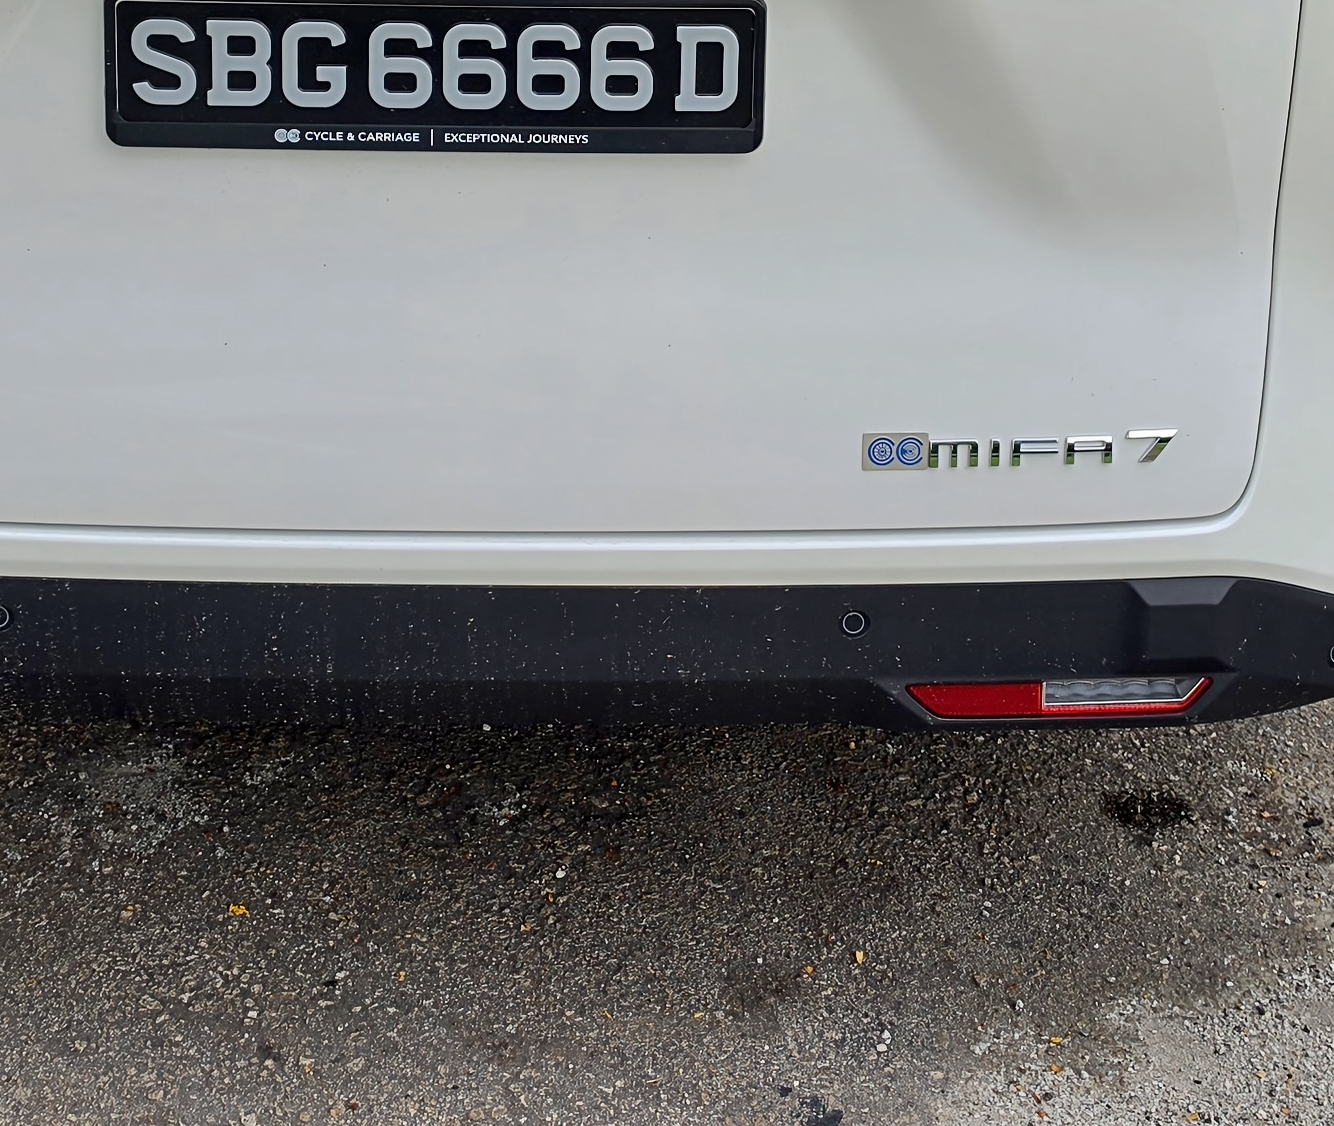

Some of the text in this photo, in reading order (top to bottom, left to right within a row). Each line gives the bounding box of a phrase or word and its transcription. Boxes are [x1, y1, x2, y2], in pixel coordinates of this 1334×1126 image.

[304, 131, 344, 143] CYCLE
[346, 132, 355, 142] &
[357, 131, 420, 143] CARRIAGE
[444, 132, 525, 144] EXCEPTIONAL
[527, 133, 589, 145] JOURNEYS
[928, 427, 1180, 469] MIFA 7
